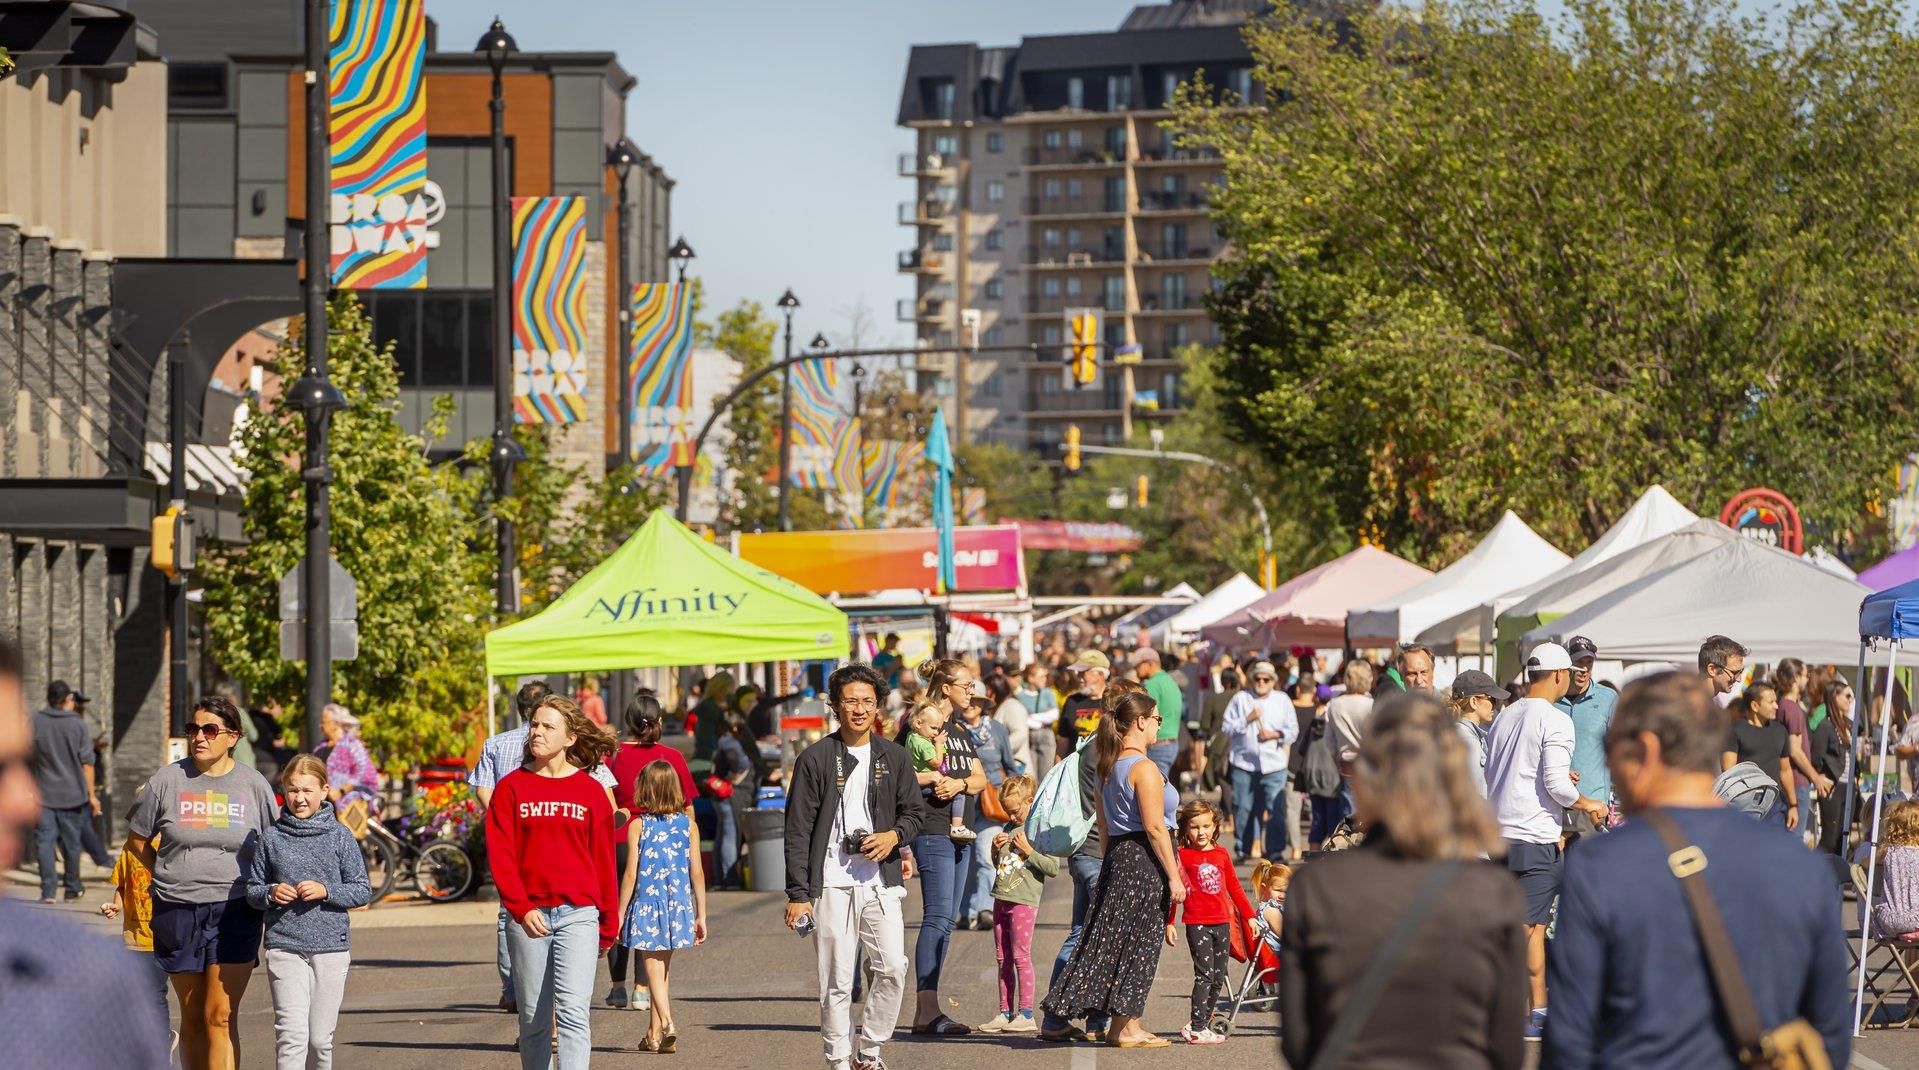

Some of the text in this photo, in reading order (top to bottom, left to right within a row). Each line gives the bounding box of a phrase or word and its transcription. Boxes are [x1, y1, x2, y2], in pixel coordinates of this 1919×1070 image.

[330, 193, 427, 223] BROA
[330, 224, 427, 254] DWAY
[513, 349, 587, 372] BROA
[513, 373, 587, 397] DWAY
[584, 588, 748, 621] Affinity
[943, 737, 971, 753] AMA
[180, 801, 245, 818] PRIDE!
[520, 801, 588, 821] SWIFTIE
